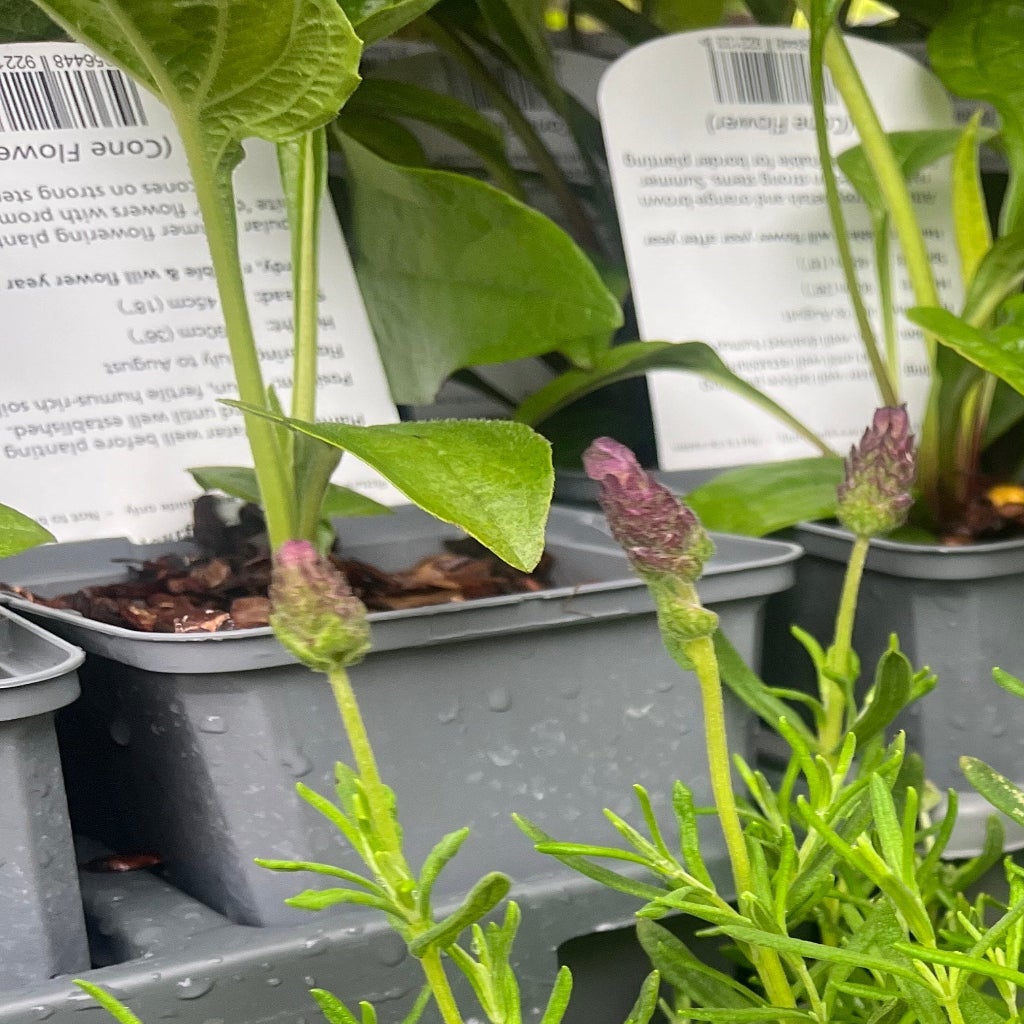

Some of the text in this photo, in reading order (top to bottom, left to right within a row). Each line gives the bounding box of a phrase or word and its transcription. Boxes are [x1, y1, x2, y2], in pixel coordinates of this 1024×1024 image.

[91, 136, 173, 160] (Cone
[0, 189, 33, 204] ste
[38, 185, 106, 202] strong
[109, 183, 138, 198] on
[59, 208, 108, 224] with
[111, 202, 186, 219] flowers
[54, 226, 155, 246] flowering
[6, 272, 52, 290] year
[56, 271, 119, 287] flower
[124, 269, 160, 285] will
[102, 357, 171, 377] August
[176, 355, 199, 370] to
[201, 351, 232, 367] uly
[127, 411, 169, 428] well
[6, 417, 124, 440] established.
[93, 433, 159, 452] before
[161, 431, 202, 448] well
[4, 436, 89, 461] planting
